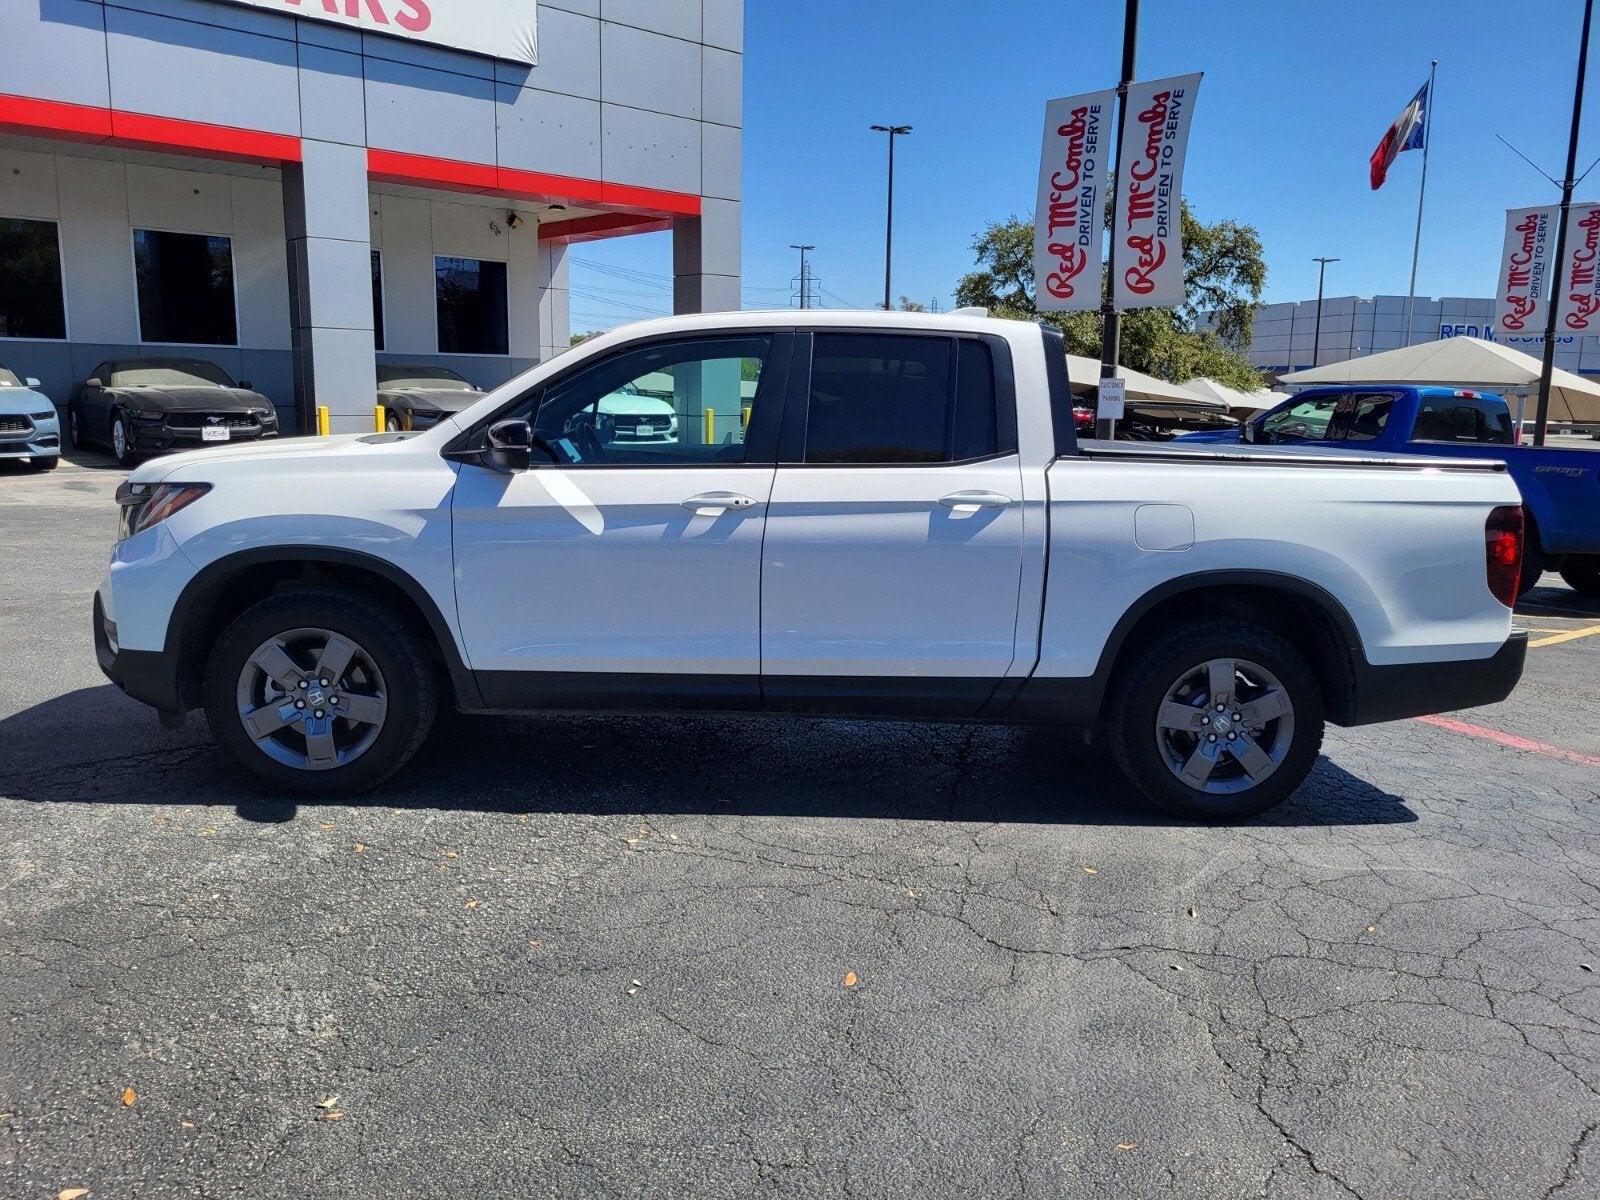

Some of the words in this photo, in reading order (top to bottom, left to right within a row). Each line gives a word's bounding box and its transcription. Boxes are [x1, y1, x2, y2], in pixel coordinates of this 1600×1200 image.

[1085, 105, 1101, 154] SERVE
[1165, 89, 1185, 139] SERVE
[1047, 106, 1088, 238] McCombs
[1083, 158, 1095, 181] TO
[1127, 91, 1171, 231] McCombs
[1161, 145, 1174, 169] TO
[1078, 187, 1093, 246] DRIVEN
[1157, 175, 1172, 238] DRIVEN
[1537, 213, 1549, 242] SERVE
[1045, 242, 1087, 298] Red
[1125, 234, 1166, 295] Red
[1506, 213, 1539, 293] McCombs
[1535, 245, 1544, 260] TO
[1530, 262, 1542, 299] DRIVEN
[1502, 296, 1536, 330] Red
[1565, 293, 1600, 329] Red
[1100, 381, 1124, 389] CUSTOMER
